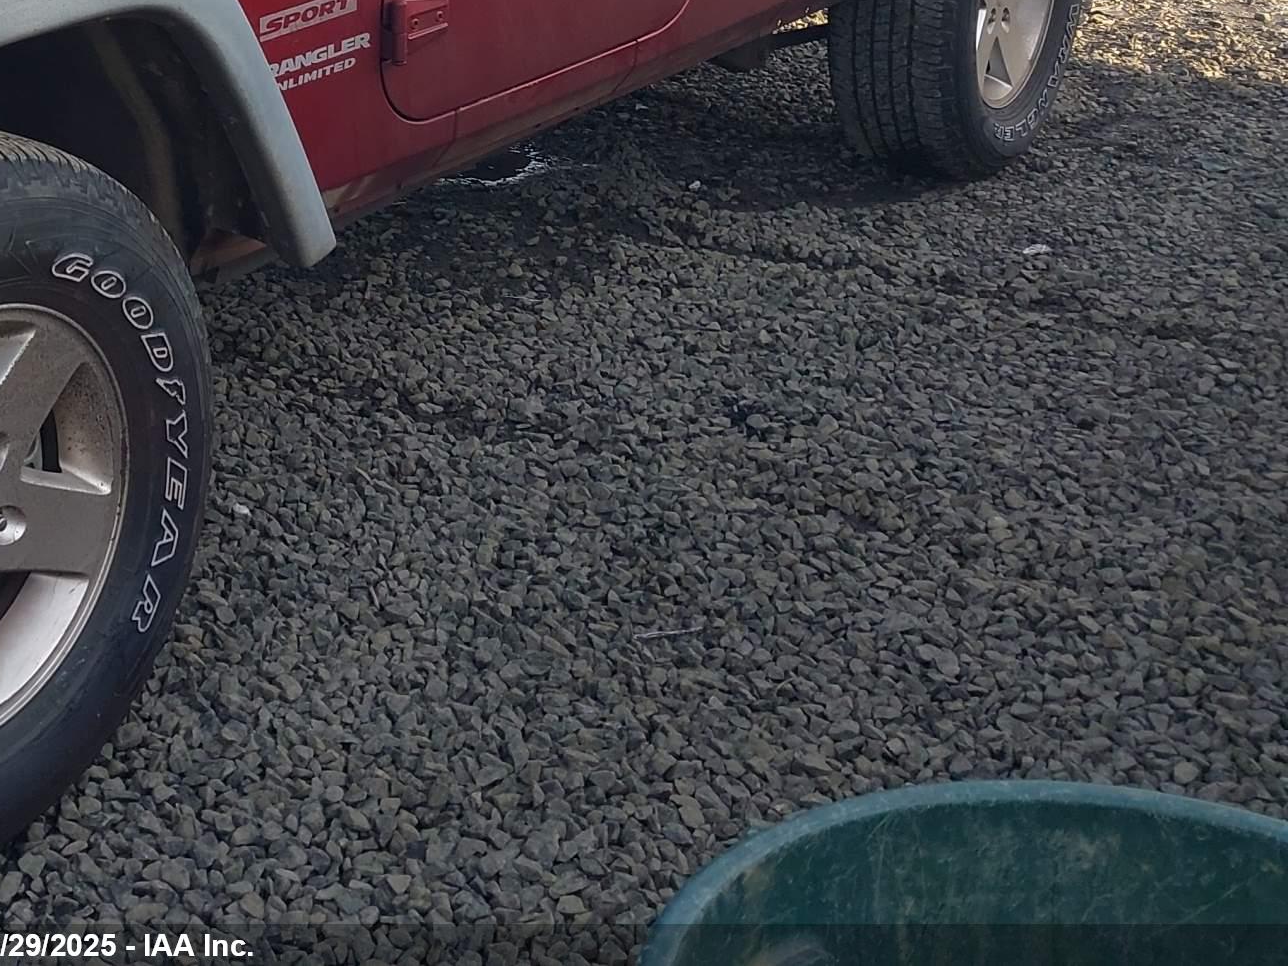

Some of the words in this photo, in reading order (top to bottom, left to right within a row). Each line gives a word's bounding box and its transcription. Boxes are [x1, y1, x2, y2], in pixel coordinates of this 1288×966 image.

[269, 33, 371, 77] RANGLER
[278, 57, 356, 90] NLIMITED
[51, 252, 187, 634] GOODYEAR
